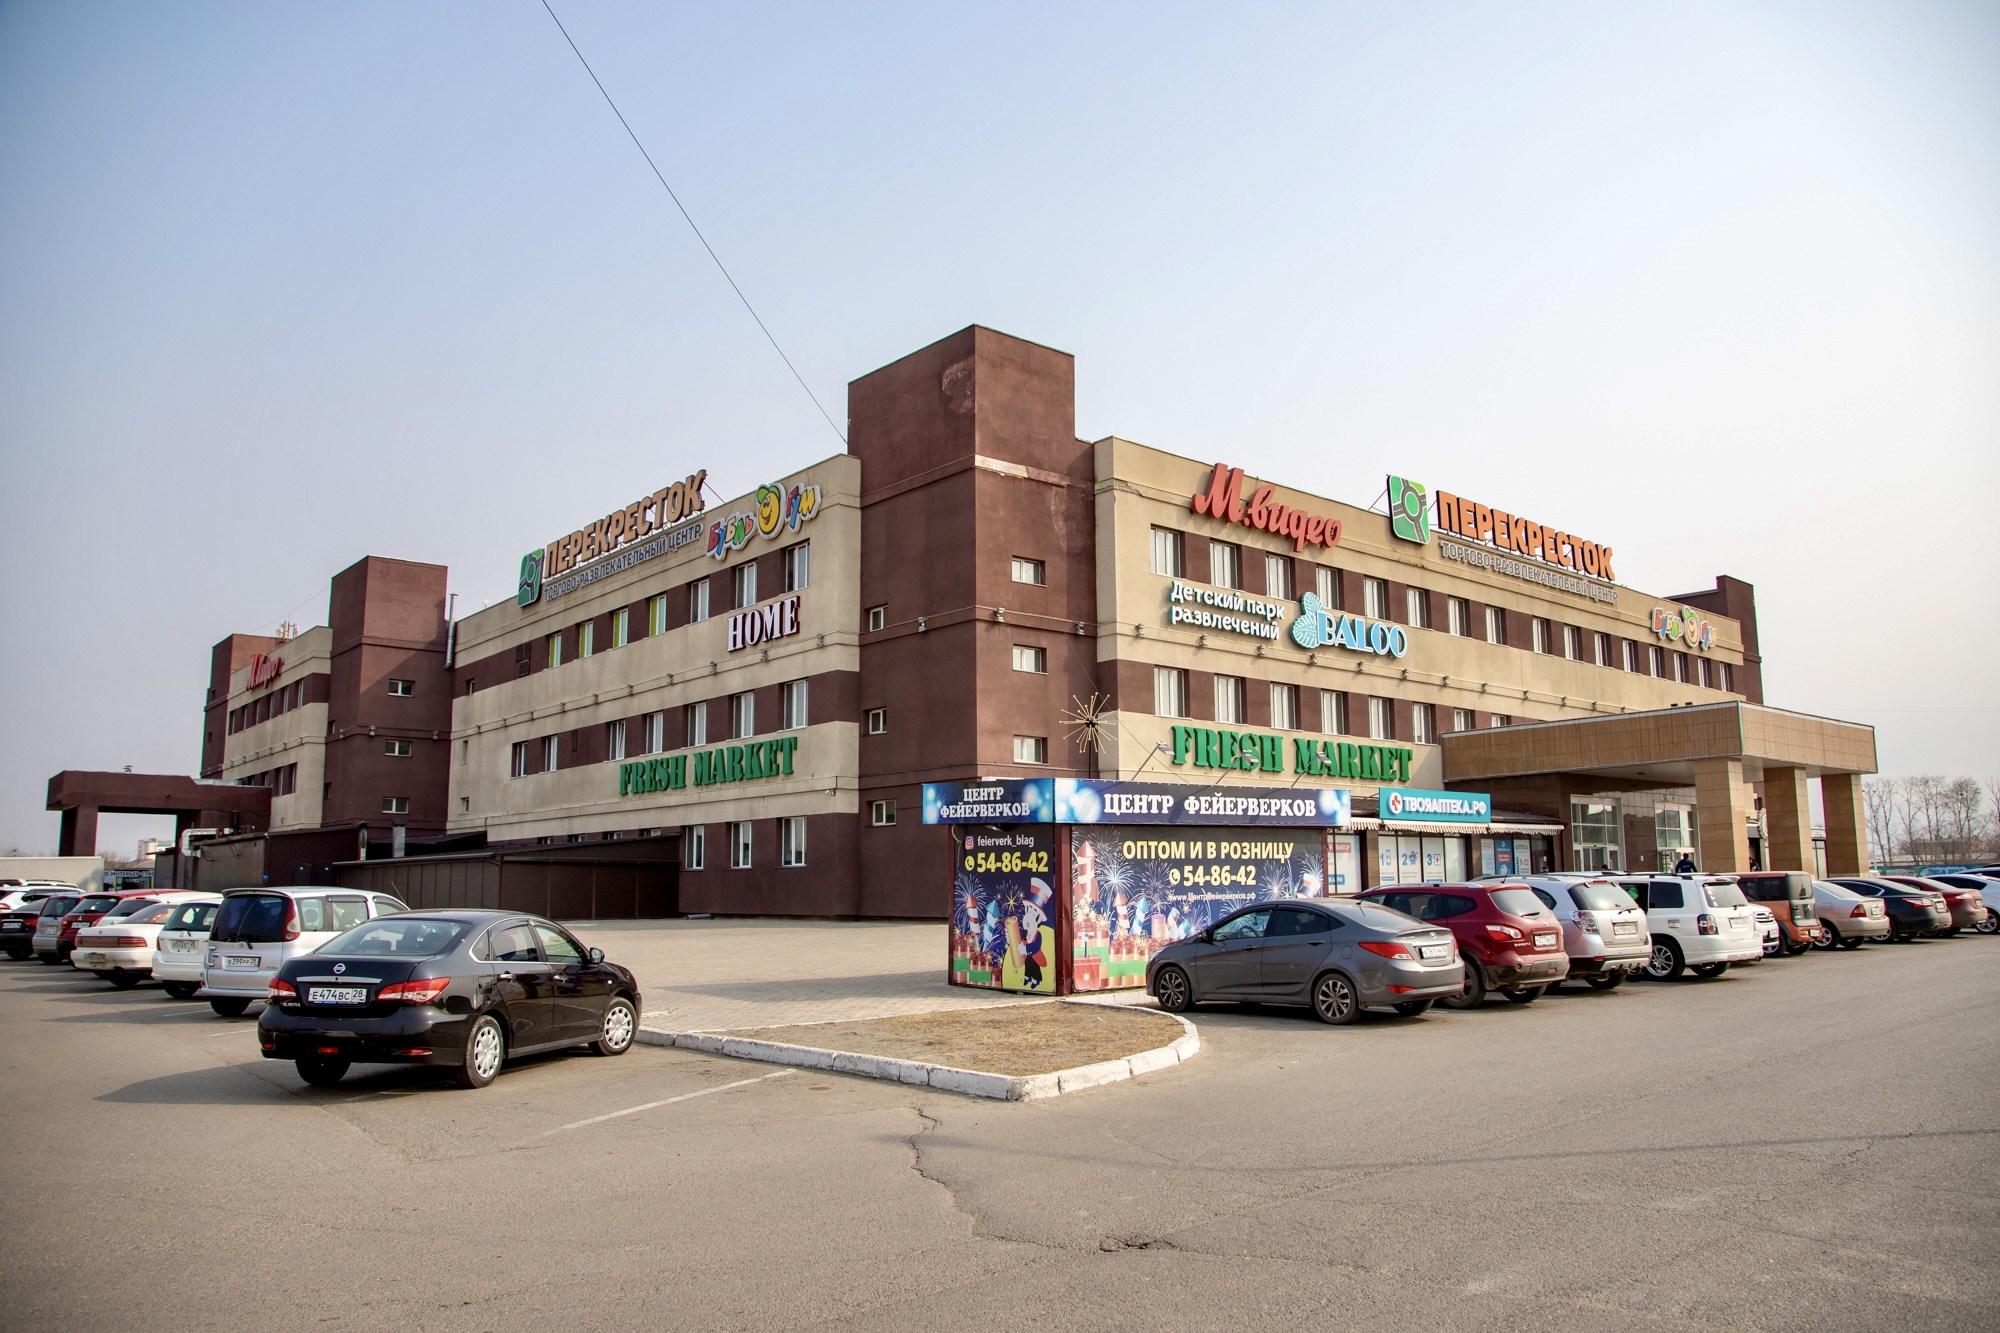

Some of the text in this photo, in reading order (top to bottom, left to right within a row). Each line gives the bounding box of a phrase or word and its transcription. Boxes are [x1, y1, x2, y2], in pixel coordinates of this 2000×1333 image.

[1192, 462, 1343, 553] М.видео
[544, 469, 707, 579] ПЕРЕКРЕСТОК
[1436, 490, 1616, 582] ПЕРЕКРЕСТОК
[544, 523, 703, 602] ТОРГОВО-РАЗВЛЕКАТЕЛЬНЫЙ ЦЕНТР
[1440, 541, 1618, 604] ТОРГОВО-РАЗВЛЕКАТЕЛЬНЫЙ ЦЕНТР
[1170, 580, 1285, 621] Детский парк
[727, 596, 800, 652] HOME
[1170, 605, 1280, 641] развлечений
[1316, 611, 1408, 658] BALOO
[619, 736, 798, 796] FRESH MARKET
[1171, 725, 1413, 782] FRESH MARKET
[963, 787, 1004, 802] ЦЕНТР
[1104, 792, 1316, 817] ЦЕНТР ФЕЙЕРВЕРКОВ
[1403, 796, 1487, 815] ТВОЯАПТЕКА.РФ
[940, 802, 1031, 818] ФЕЙЕРВЕРКОВ
[977, 834, 1035, 848] feierverk_blag
[1123, 841, 1294, 864] ОПТОМ И В РОЗНИЦУ
[977, 851, 1049, 873] 54-86-42
[1402, 854, 1408, 866] 2
[1426, 853, 1433, 866] 3
[1183, 865, 1257, 887] 54-86-42
[312, 989, 363, 1001] Е474ВС 28
